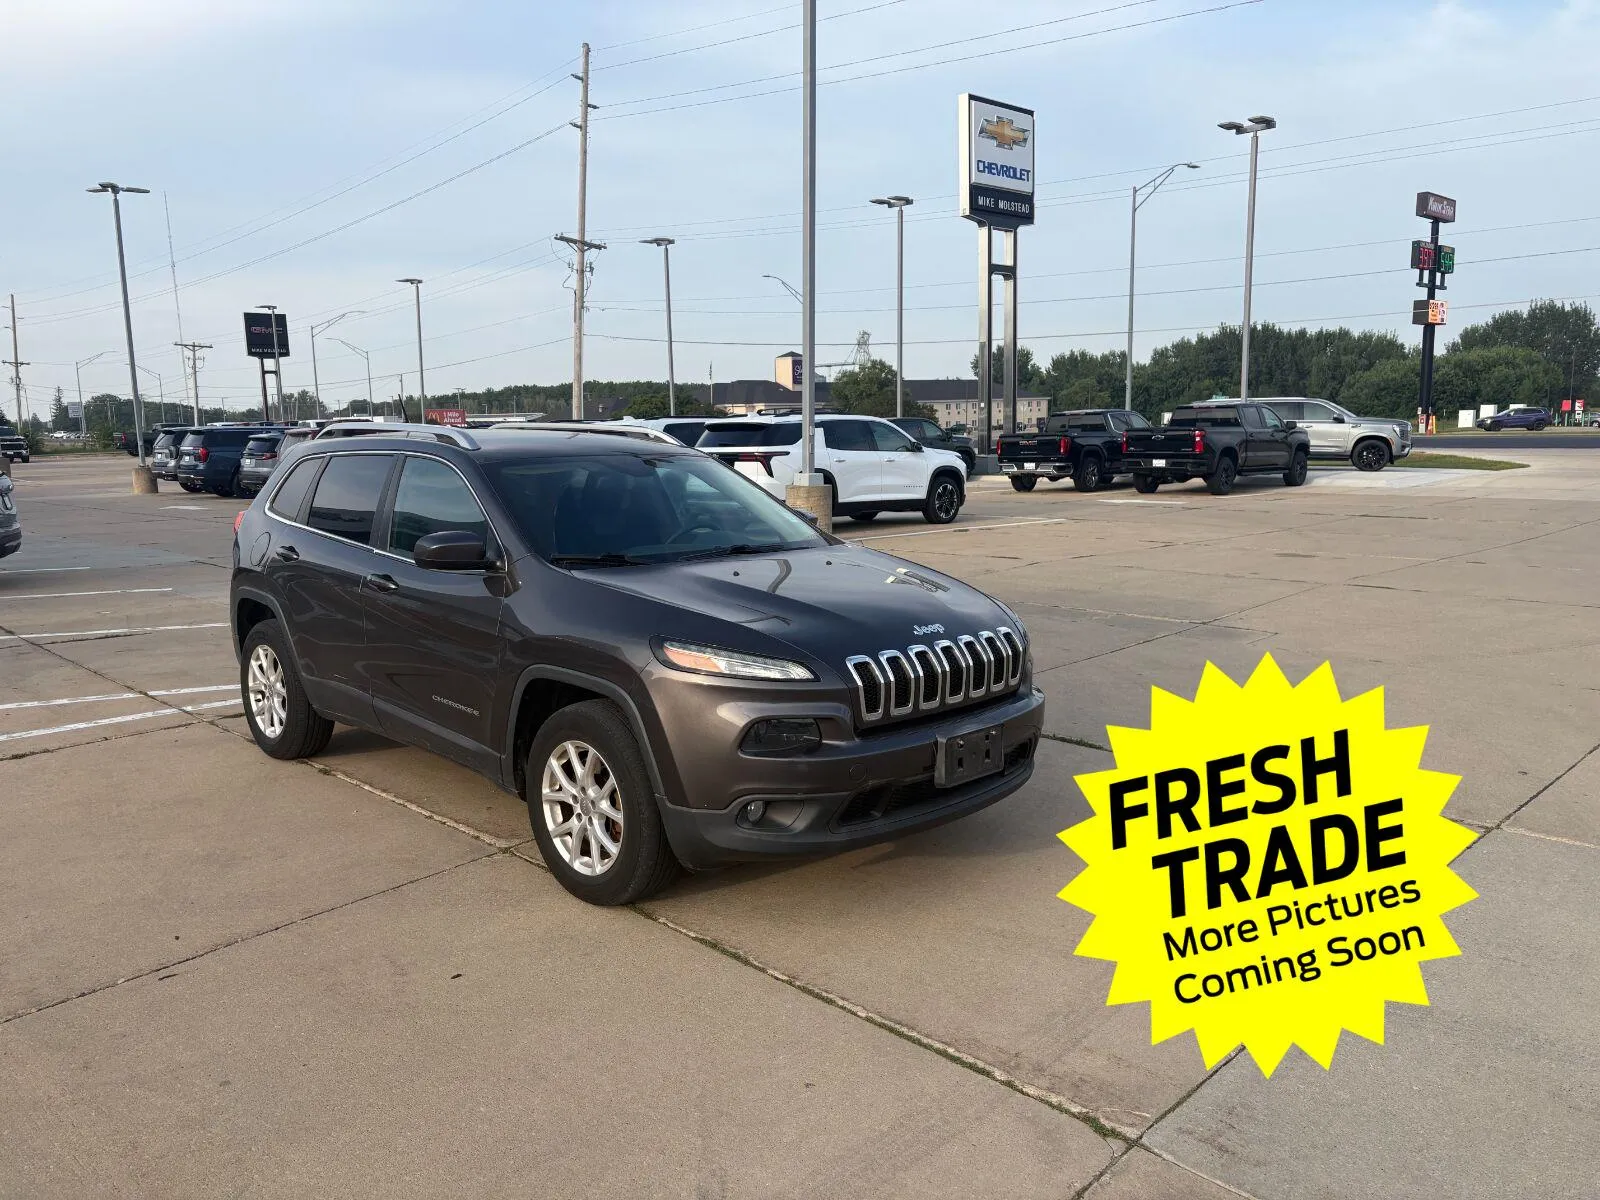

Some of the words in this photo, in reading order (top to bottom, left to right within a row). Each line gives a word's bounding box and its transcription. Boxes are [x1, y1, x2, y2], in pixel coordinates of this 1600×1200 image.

[977, 160, 1031, 182] CHEVROLET
[978, 195, 995, 208] MIKE
[998, 199, 1030, 213] MOLSTEAD
[913, 623, 945, 635] Jeep
[432, 694, 480, 717] CHEROKEE
